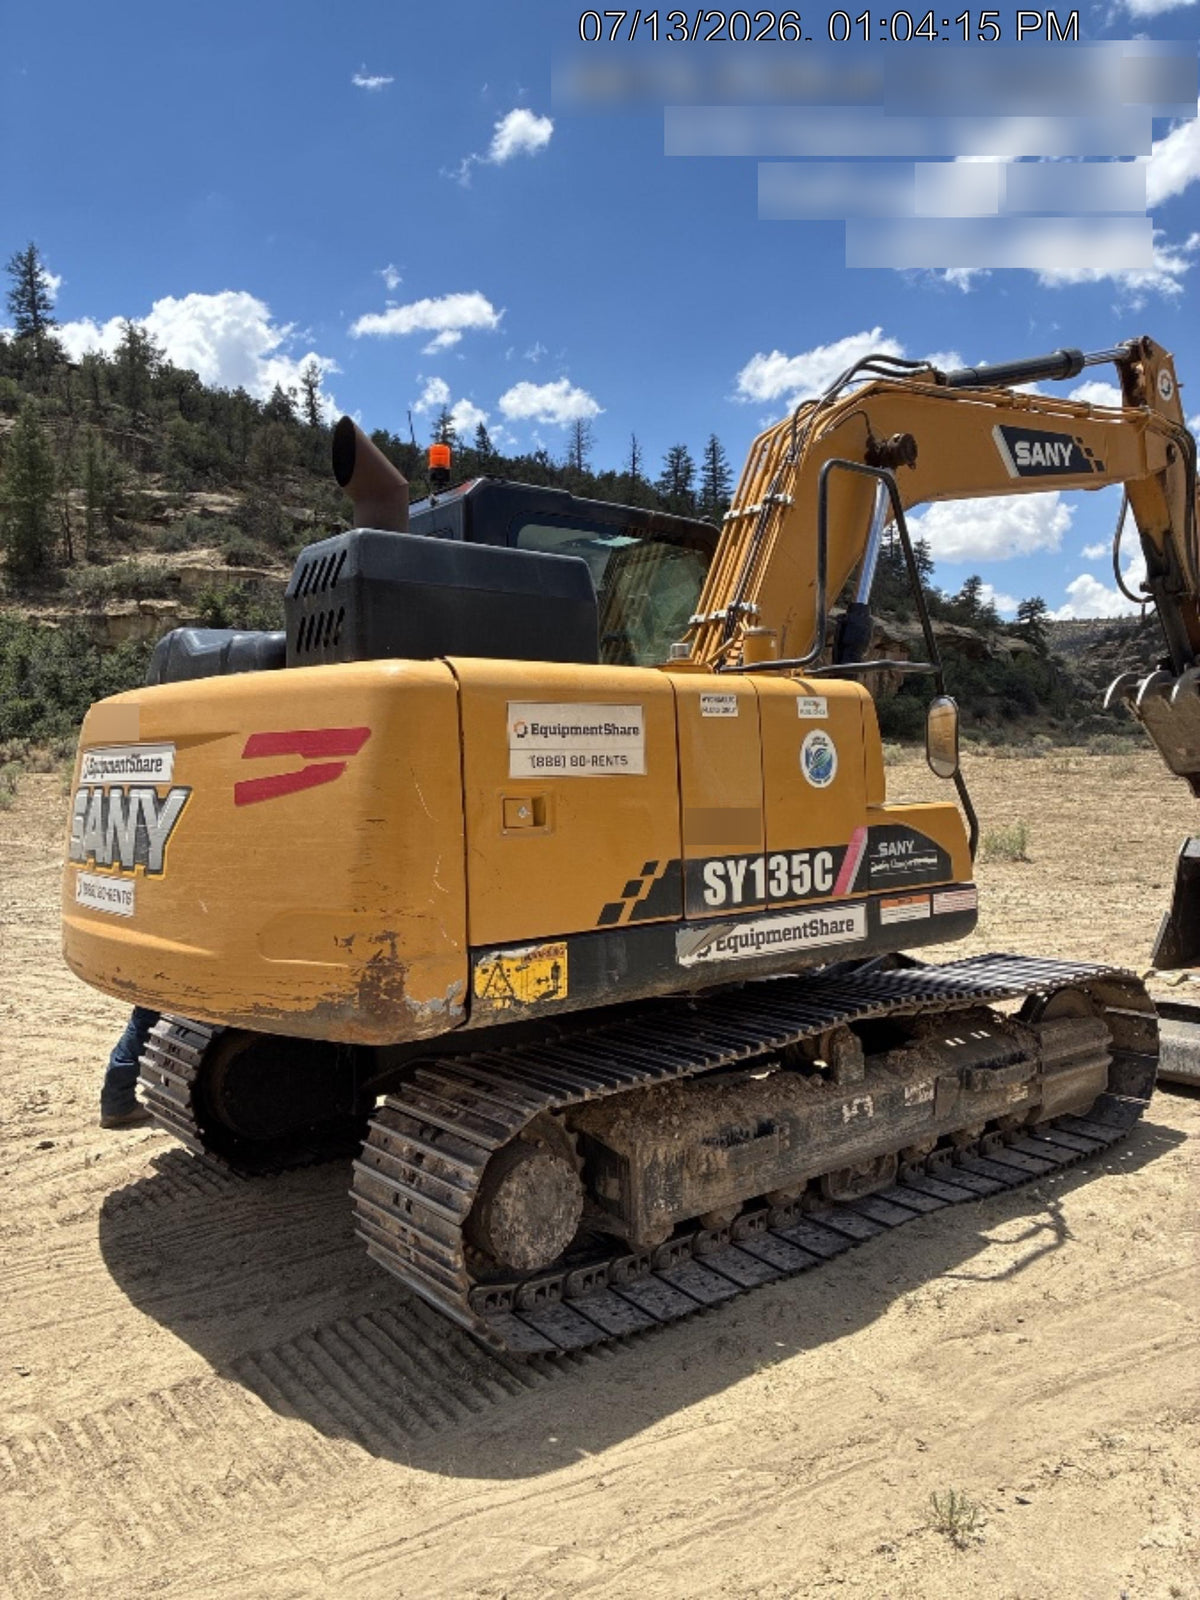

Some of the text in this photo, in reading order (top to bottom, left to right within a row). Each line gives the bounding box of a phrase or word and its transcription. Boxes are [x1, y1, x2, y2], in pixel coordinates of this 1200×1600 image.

[1014, 440, 1074, 467] SANY
[531, 722, 640, 739] EquipmentShare
[529, 754, 629, 768] (888) 80-RENTS
[70, 786, 192, 875] SANY
[878, 840, 915, 857] SANY
[702, 851, 833, 906] SY135C
[715, 918, 854, 953] EquipmentShare
